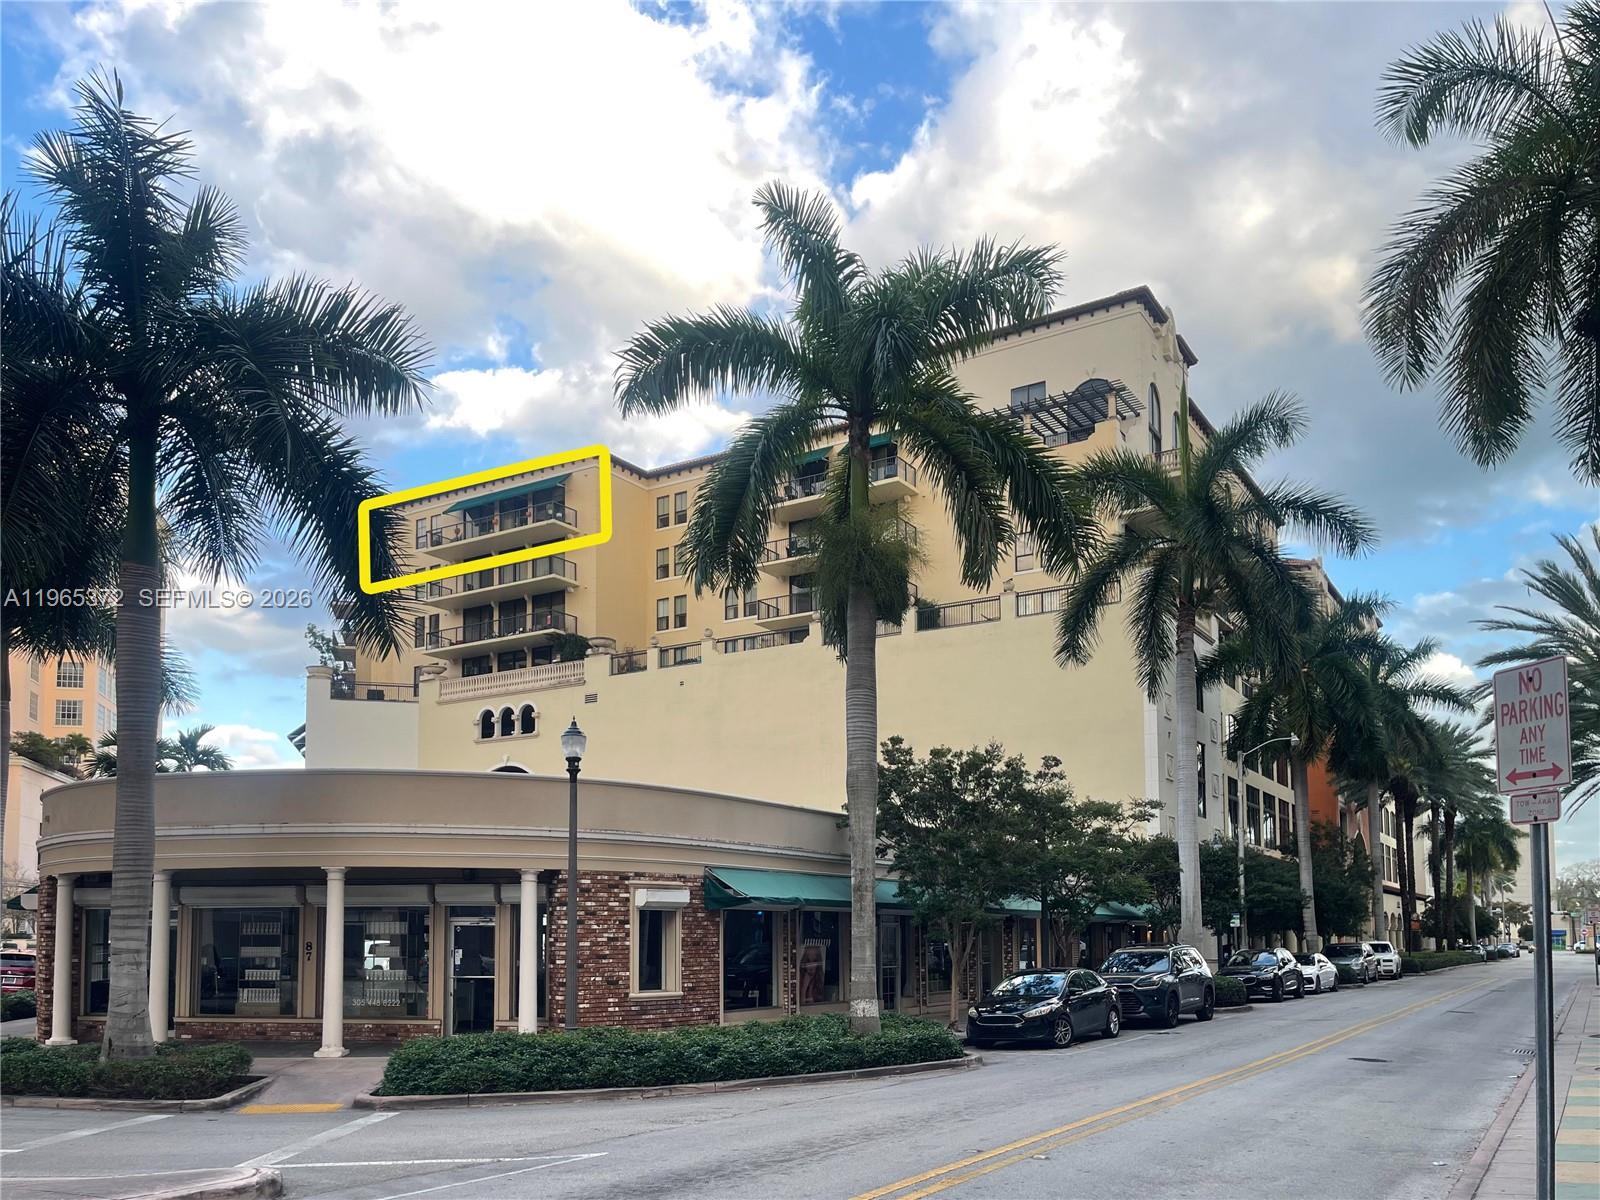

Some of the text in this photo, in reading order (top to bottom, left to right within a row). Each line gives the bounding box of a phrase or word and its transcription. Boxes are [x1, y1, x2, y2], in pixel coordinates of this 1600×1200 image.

[1519, 667, 1542, 694] NO
[1501, 692, 1564, 727] PARKING
[1520, 723, 1546, 745] ANY
[1519, 746, 1546, 765] TIME
[352, 998, 366, 1007] 305
